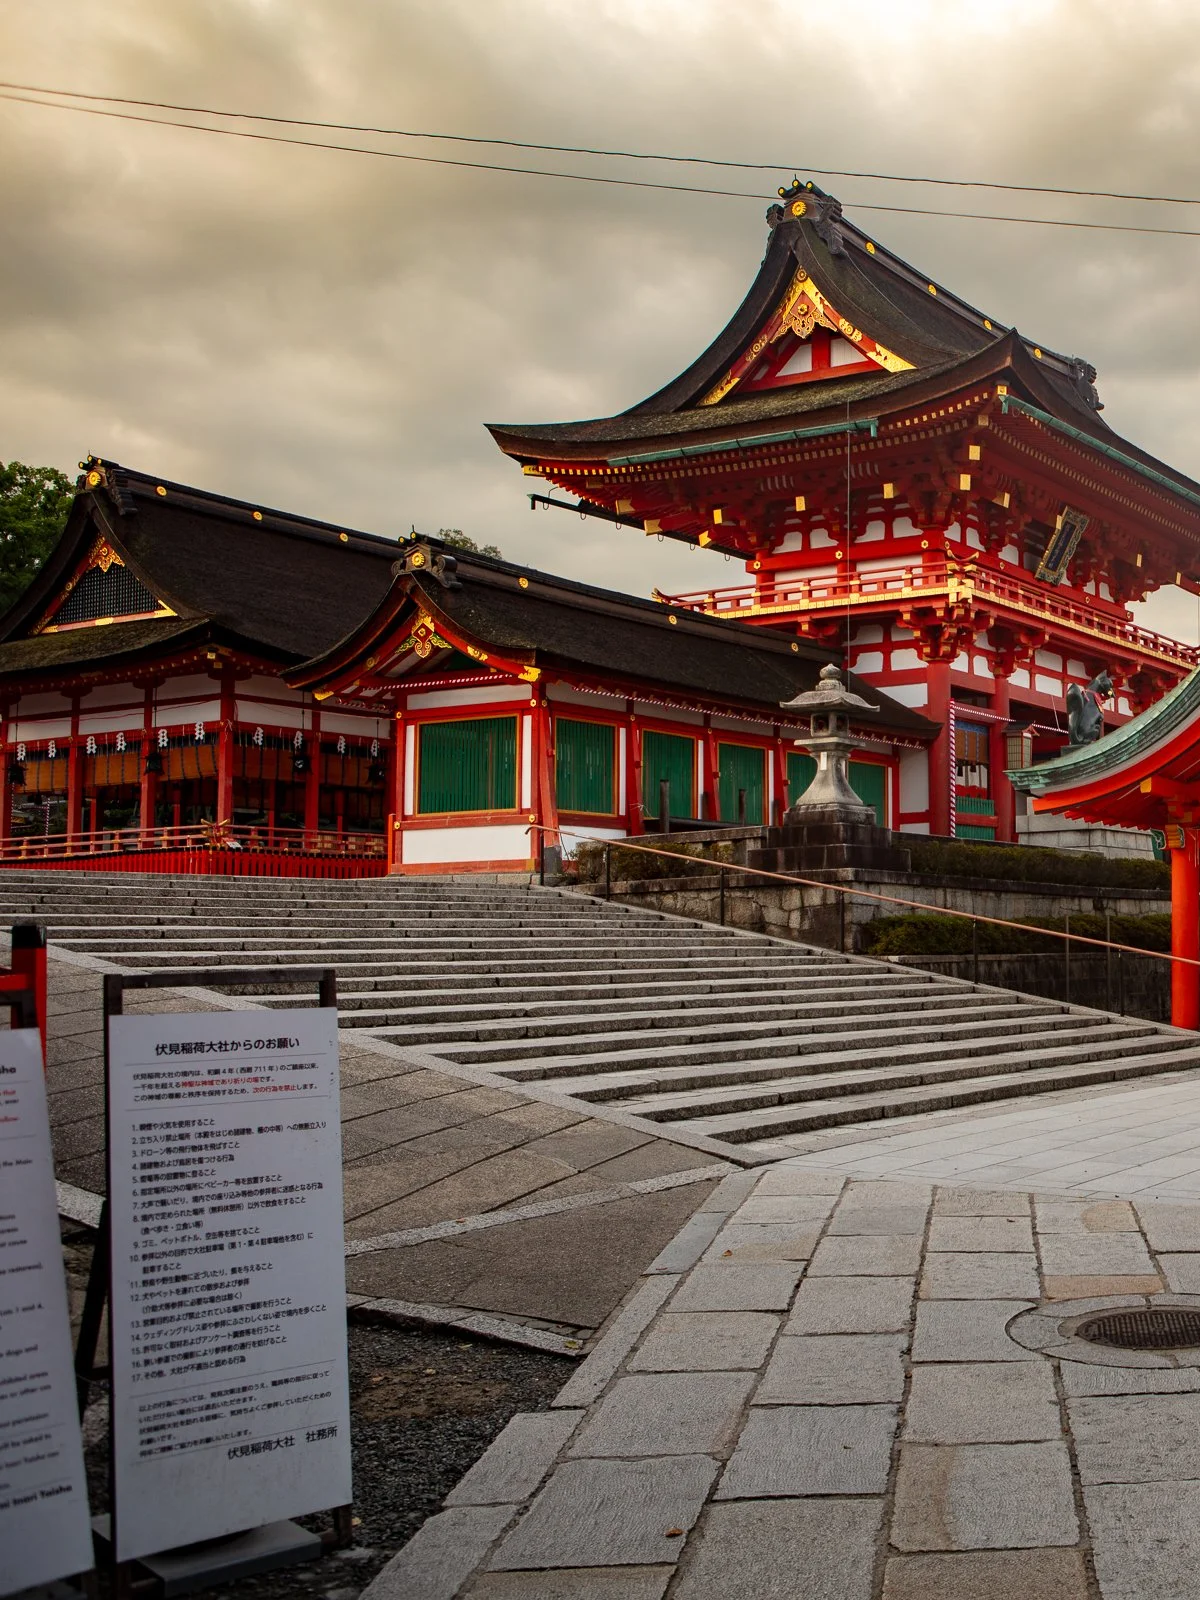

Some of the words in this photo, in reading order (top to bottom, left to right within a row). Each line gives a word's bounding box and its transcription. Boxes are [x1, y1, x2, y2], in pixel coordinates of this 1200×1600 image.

[155, 1037, 299, 1056] 伏見稲荷大社からのお願い
[227, 1435, 295, 1460] 伏見稲荷大社
[305, 1426, 337, 1443] 社務所
